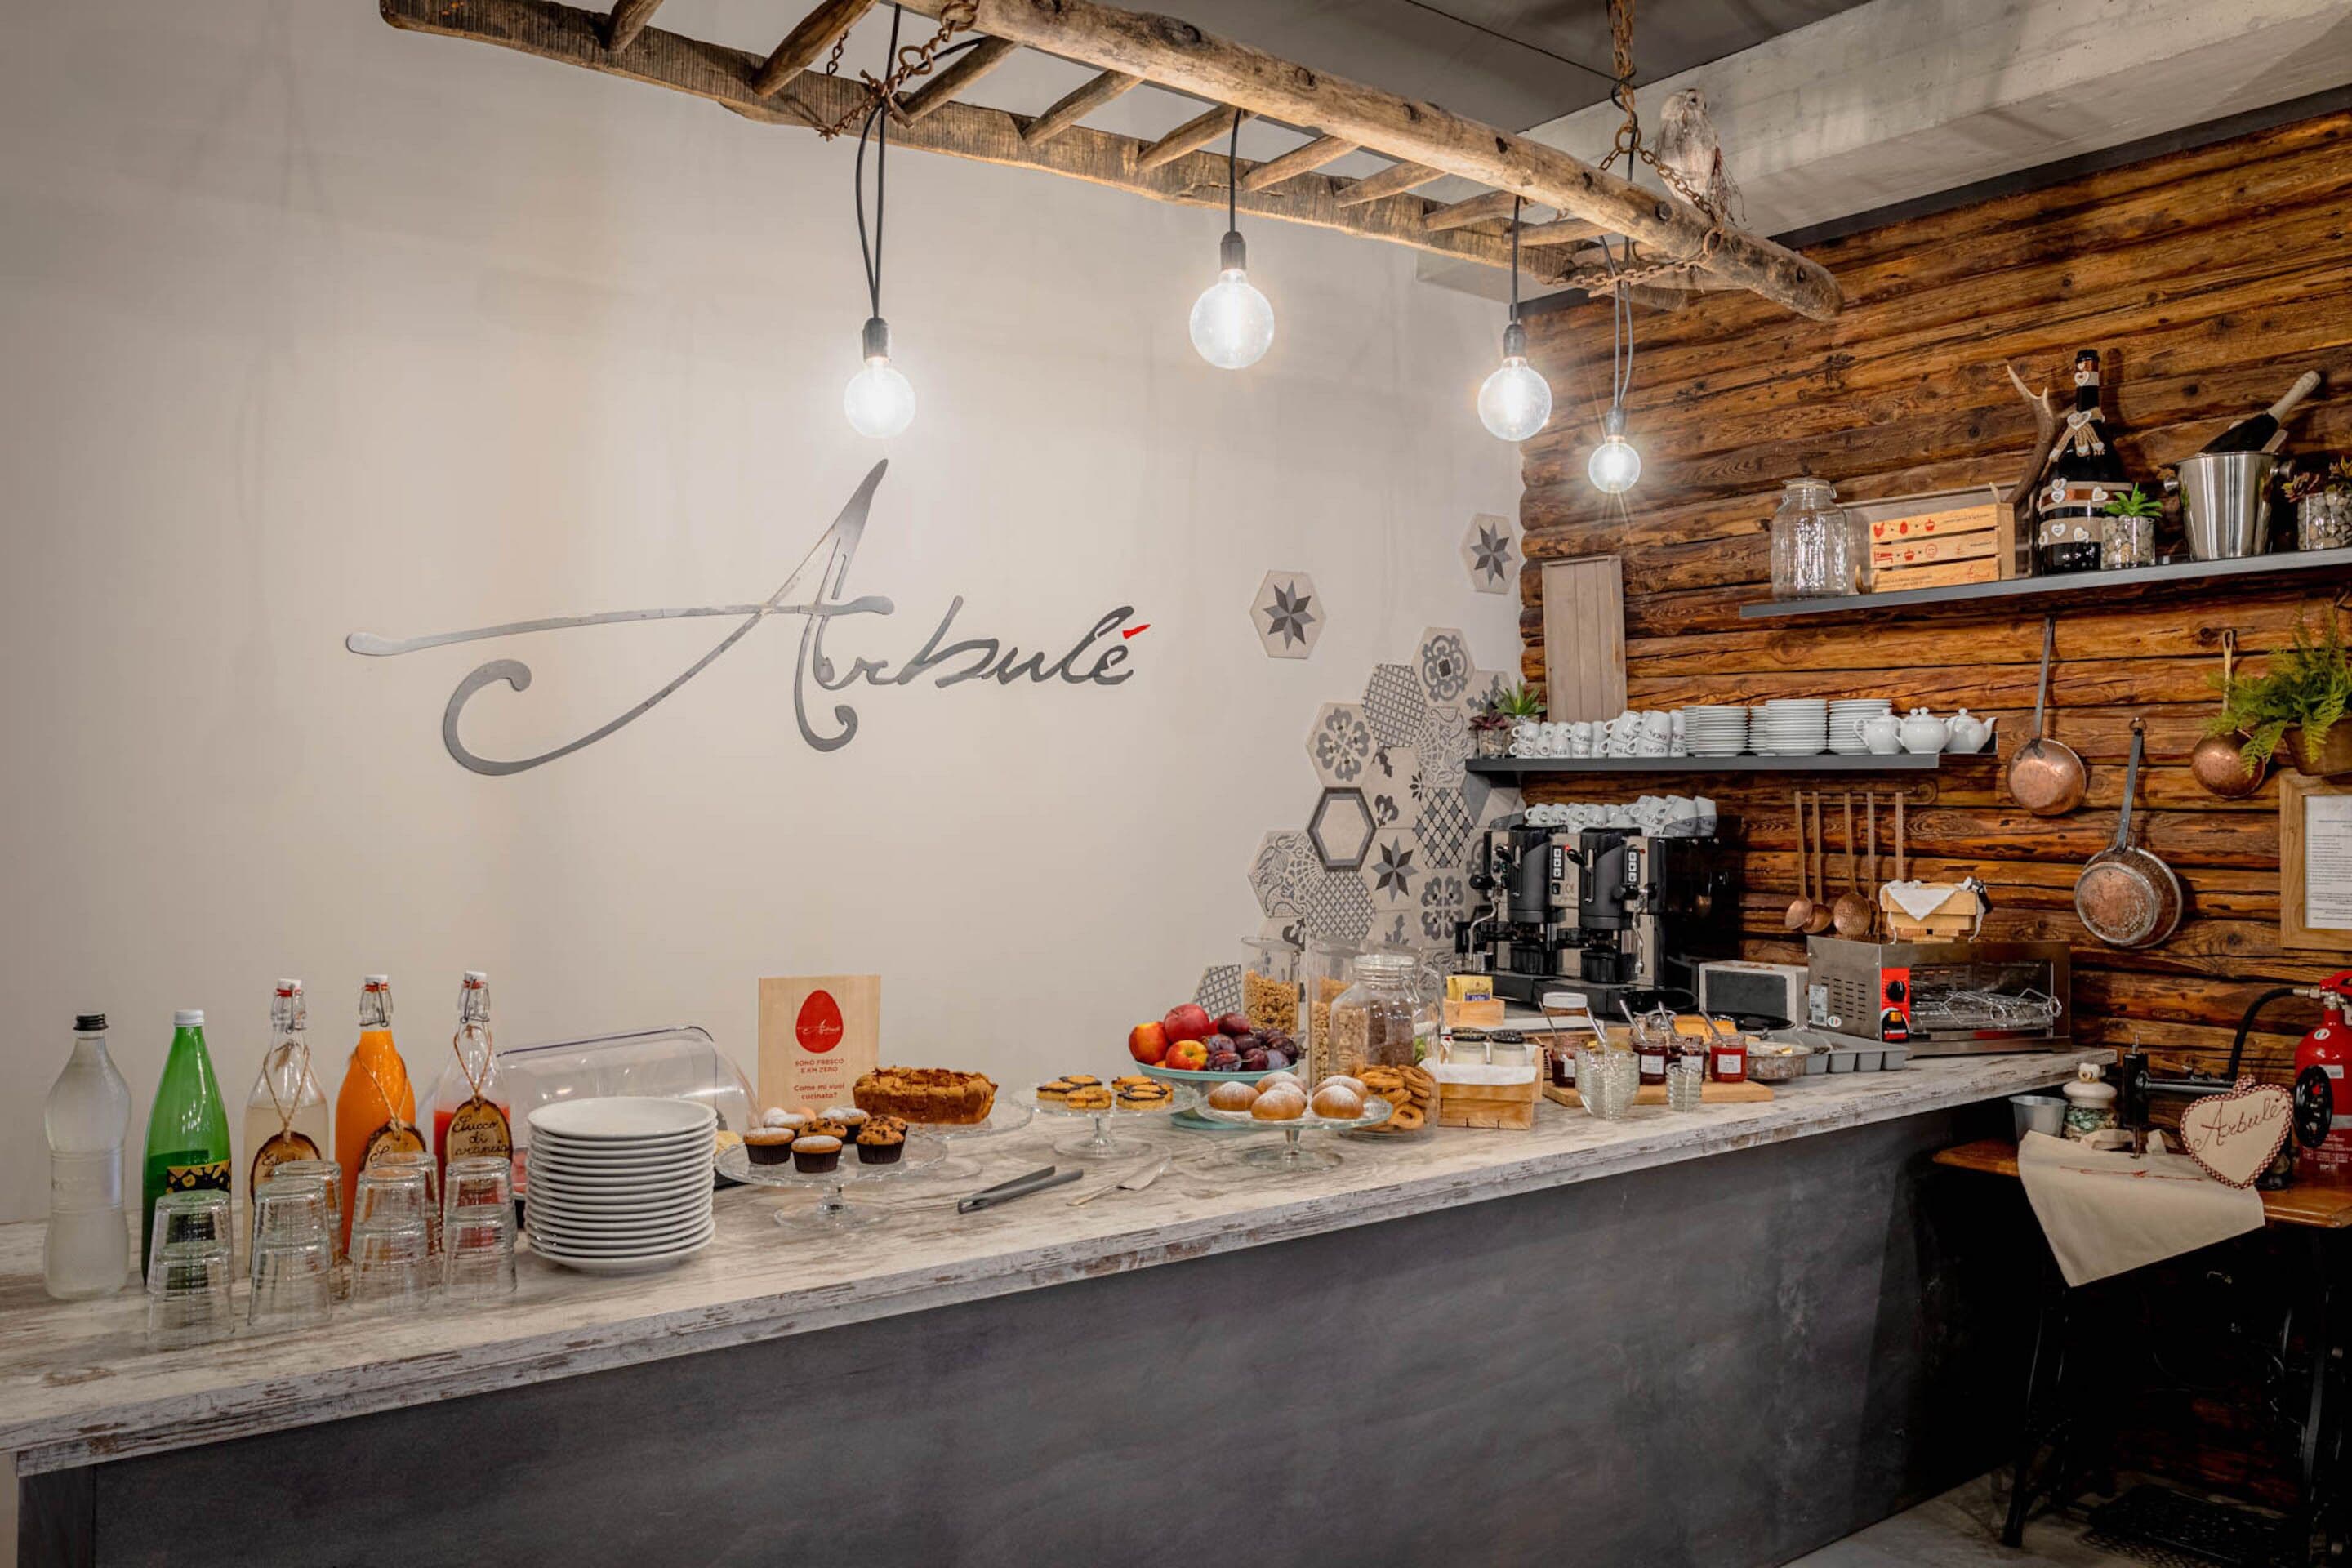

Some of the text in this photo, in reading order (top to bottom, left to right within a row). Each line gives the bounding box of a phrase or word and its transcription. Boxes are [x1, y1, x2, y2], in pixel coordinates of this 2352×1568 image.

[345, 458, 1150, 776] Arbulé
[817, 1083, 827, 1091] mi
[469, 1130, 488, 1144] di
